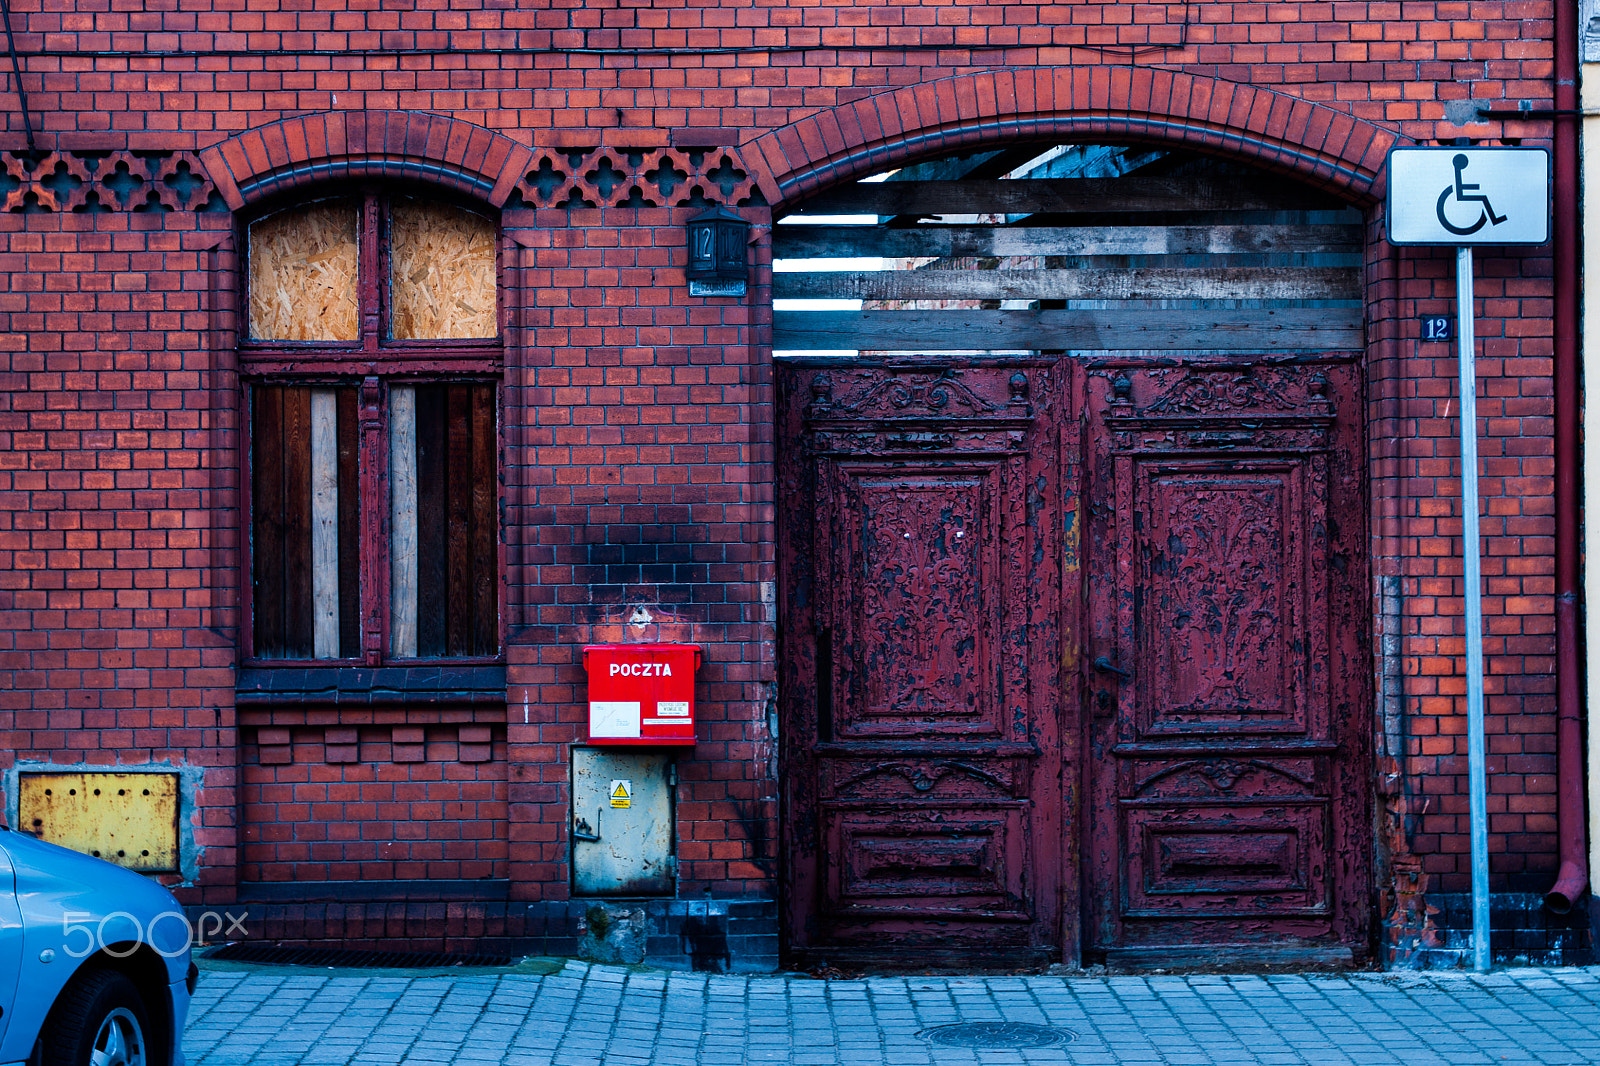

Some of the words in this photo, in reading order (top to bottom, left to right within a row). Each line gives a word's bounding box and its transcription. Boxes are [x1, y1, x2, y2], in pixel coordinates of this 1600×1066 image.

[693, 227, 711, 258] 12
[1426, 318, 1448, 339] 12
[609, 663, 672, 677] POCZTA
